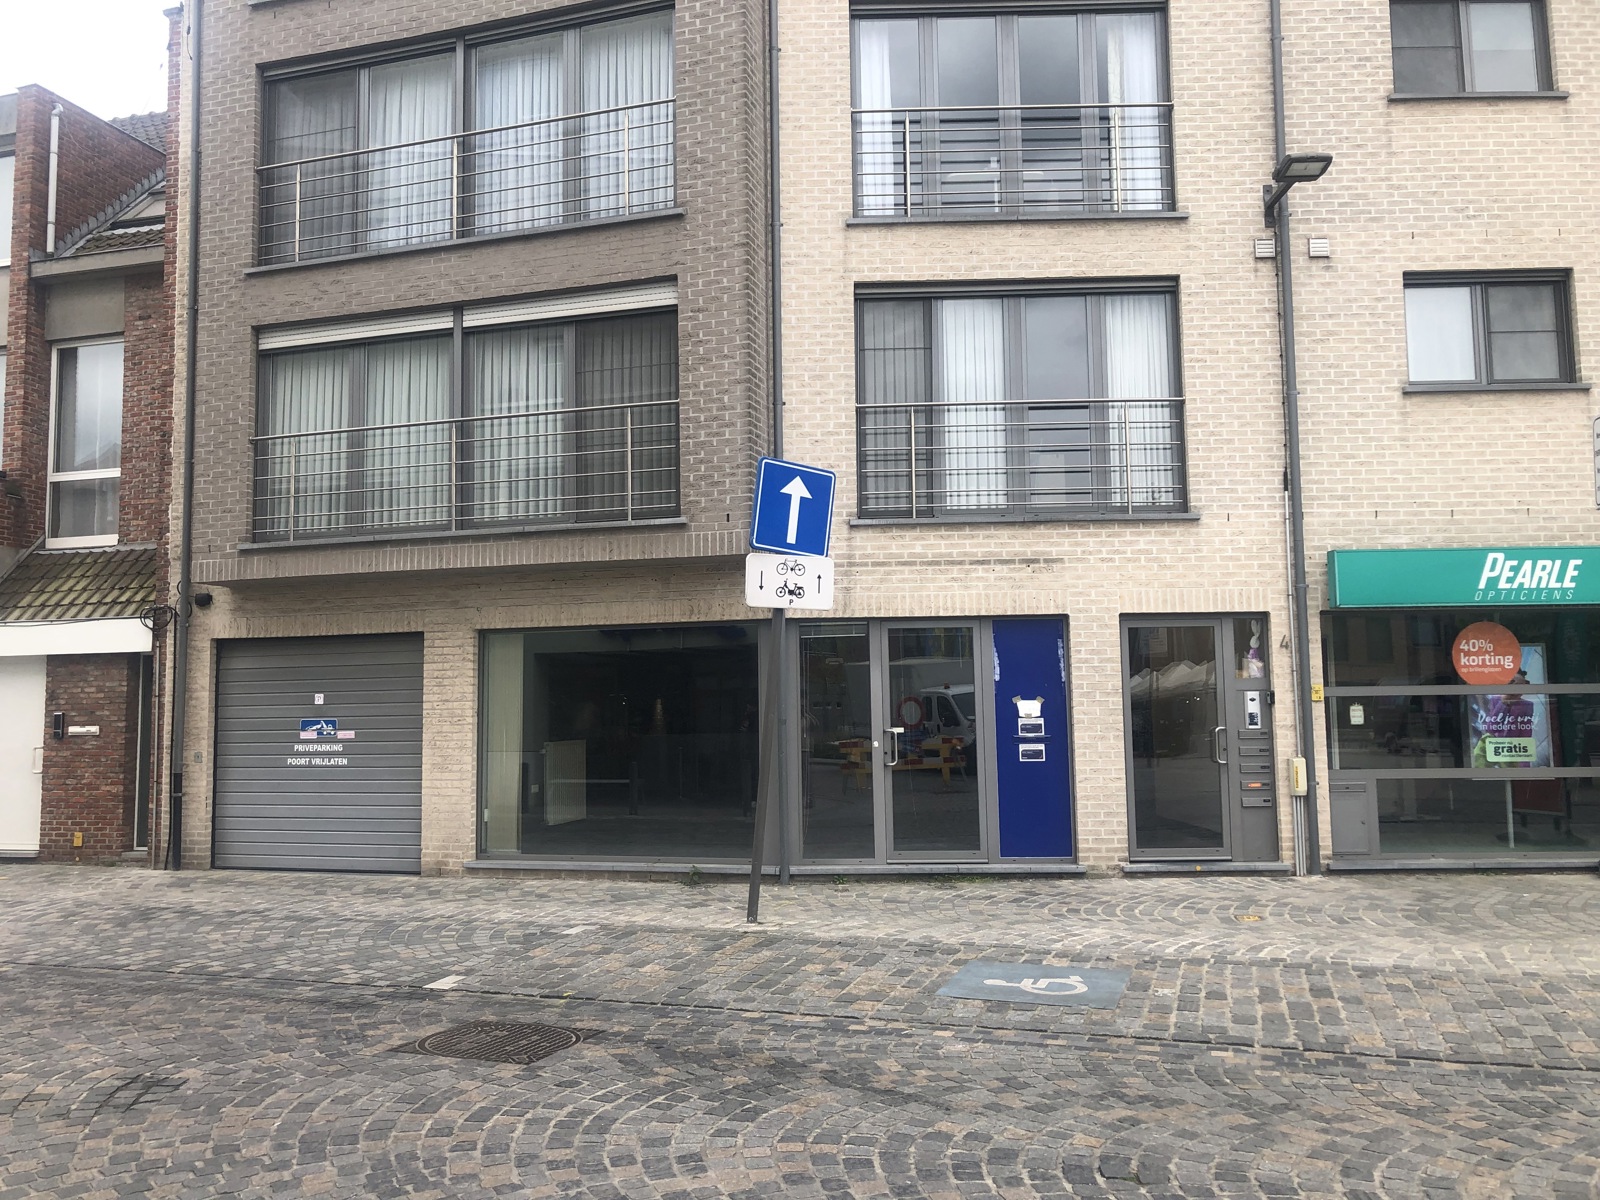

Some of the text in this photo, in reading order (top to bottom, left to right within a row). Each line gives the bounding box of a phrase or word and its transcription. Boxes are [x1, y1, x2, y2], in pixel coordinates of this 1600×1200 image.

[1477, 552, 1583, 589] PEARLE
[1474, 589, 1574, 601] OPTICIENS
[1460, 639, 1494, 651] 40%
[1460, 652, 1514, 669] korting
[1504, 713, 1516, 725] je
[1489, 722, 1516, 731] iedere
[294, 744, 343, 752] PRIVEPARKING
[1493, 742, 1529, 757] gratis
[287, 758, 348, 766] POORT VRIJLATEN
